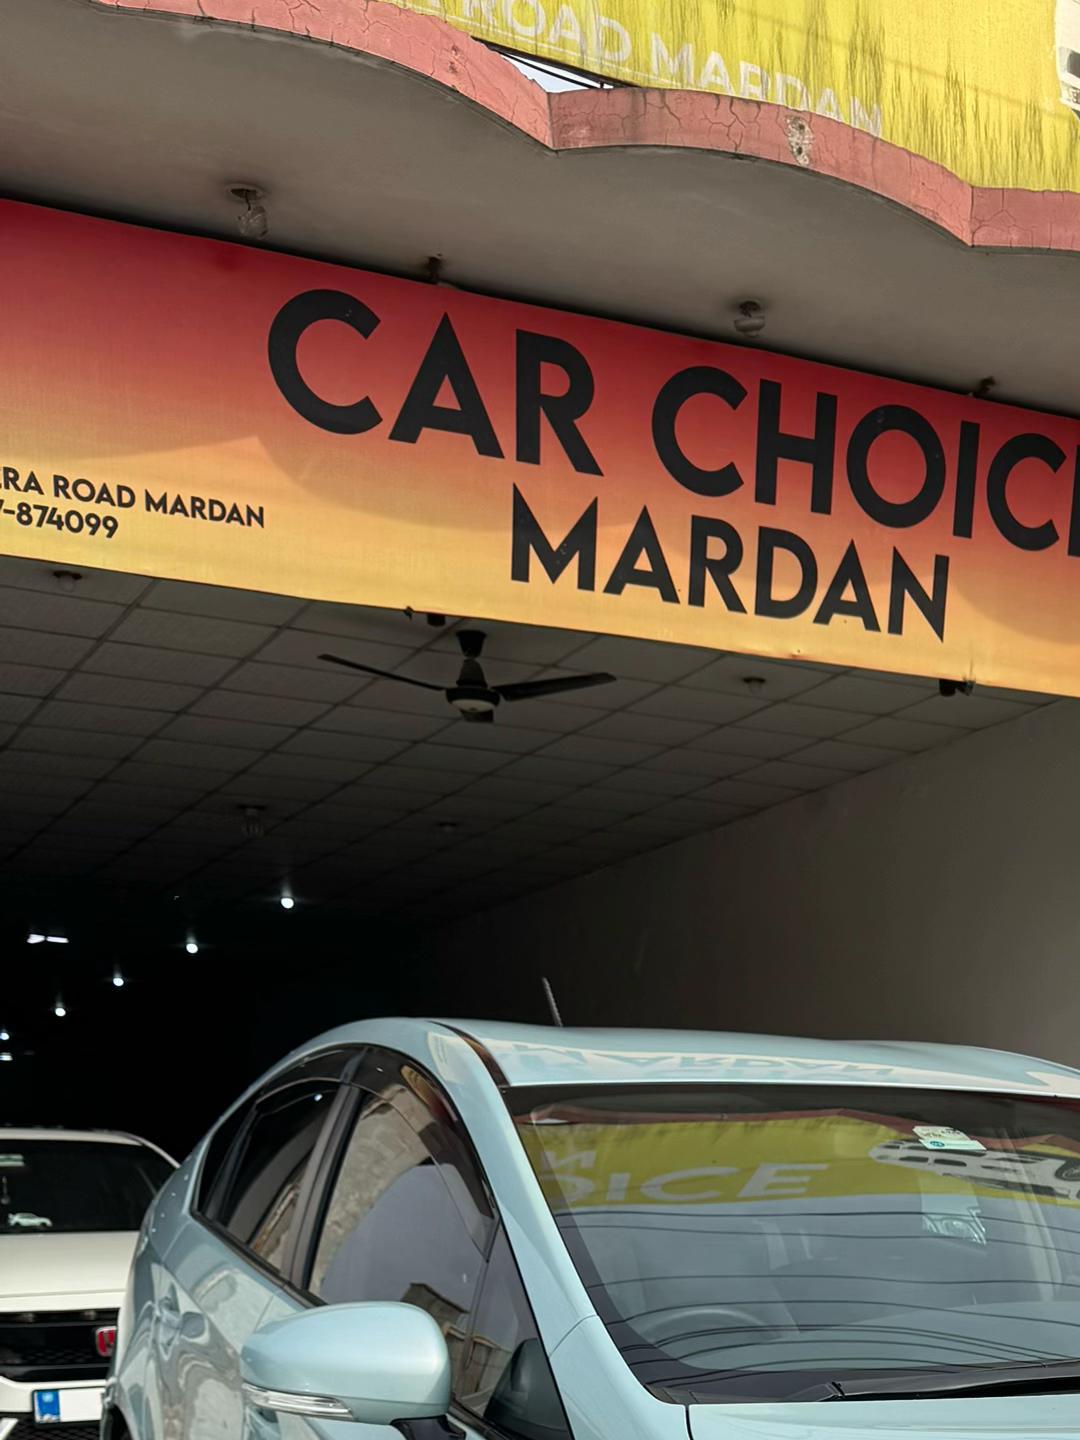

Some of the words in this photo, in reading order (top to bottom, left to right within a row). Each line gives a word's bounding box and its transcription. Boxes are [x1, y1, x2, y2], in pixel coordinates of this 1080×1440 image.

[651, 32, 881, 138] MARDAN
[267, 288, 604, 476] CAR
[0, 466, 45, 495] RA
[53, 474, 136, 508] ROAD
[144, 489, 265, 528] MARDAN
[511, 482, 950, 643] MARDAN
